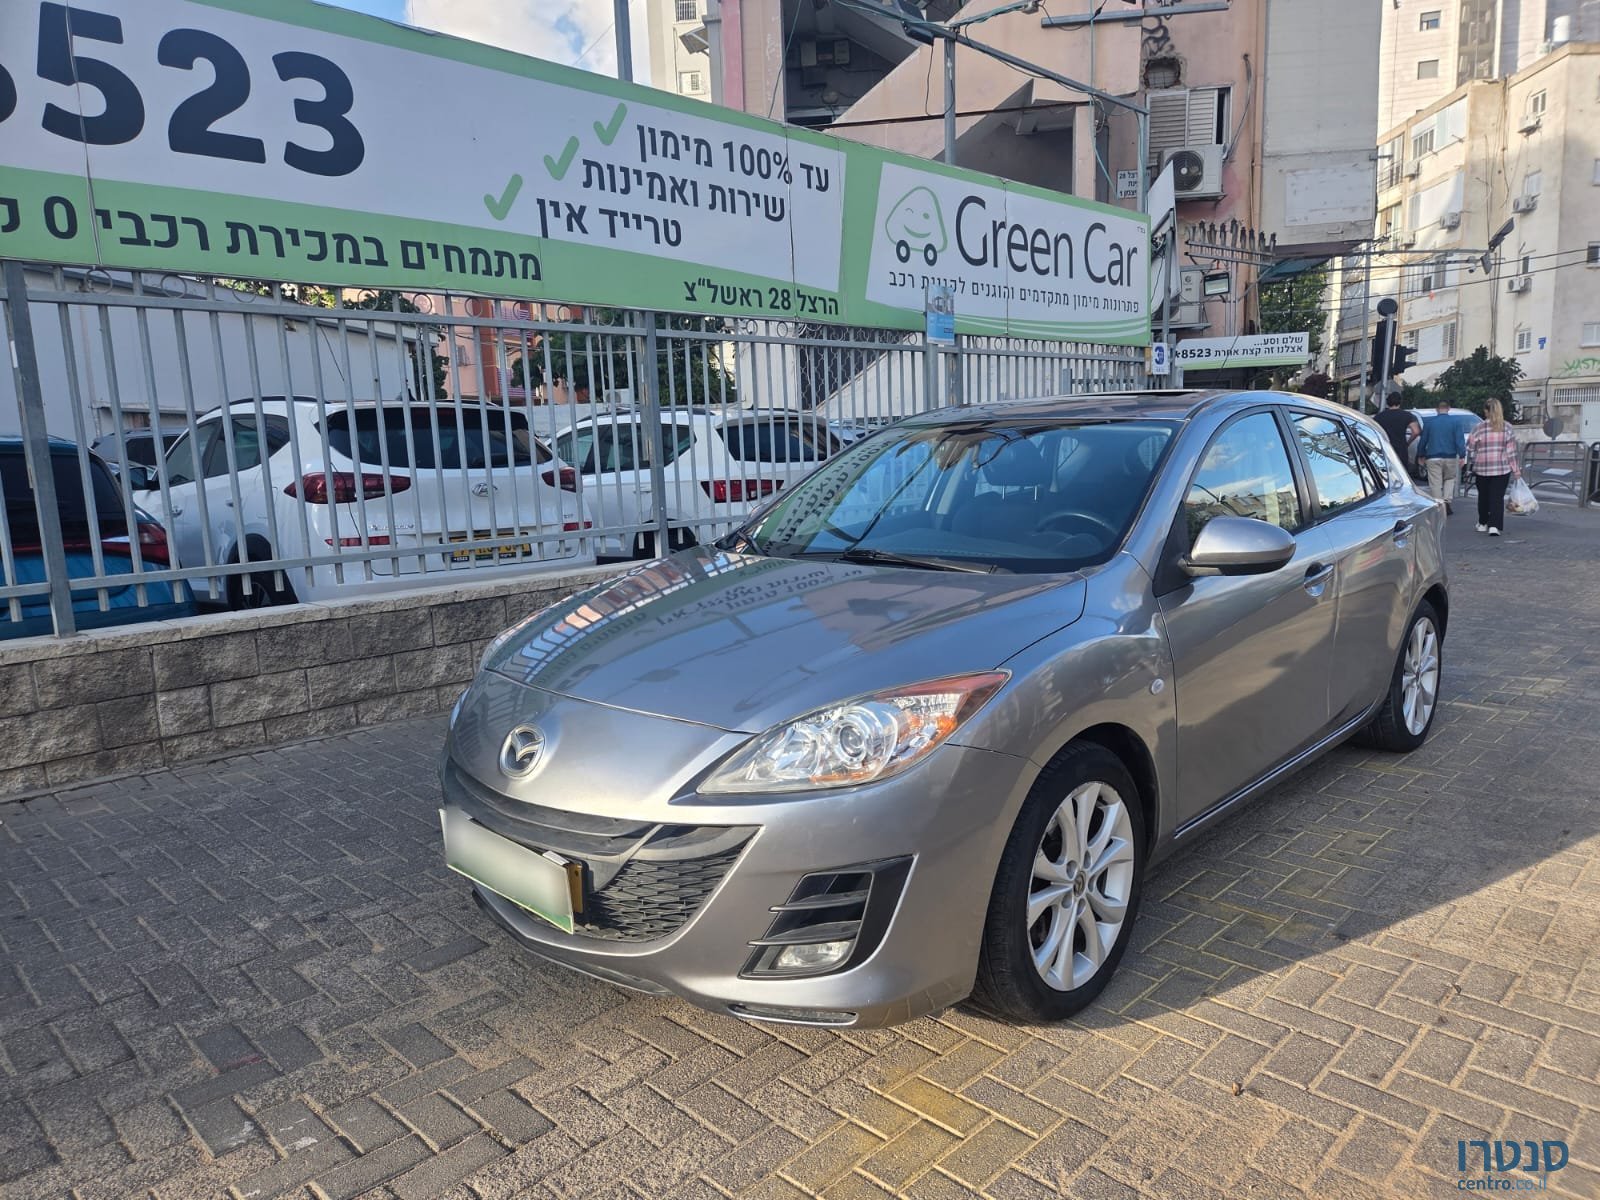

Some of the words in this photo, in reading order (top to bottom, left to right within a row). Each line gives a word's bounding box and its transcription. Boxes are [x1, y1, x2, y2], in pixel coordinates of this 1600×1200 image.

[0, 1, 365, 177] 523
[637, 124, 713, 167] מימון
[722, 141, 793, 185] 100%
[799, 162, 830, 192] עד
[582, 158, 699, 208] ואמינות
[708, 184, 786, 222] שירות
[95, 208, 210, 252] רכבי
[537, 198, 589, 239] אין
[598, 206, 682, 247] טרייד
[226, 221, 389, 268] במכירת
[955, 195, 1074, 280] Green
[1084, 222, 1138, 288] Car
[401, 238, 542, 282] מתמחים
[889, 271, 915, 288] רכב
[971, 281, 1015, 300] והוגנים
[768, 287, 792, 312] 28
[798, 287, 839, 316] הרצל
[1019, 287, 1069, 308] מתקדמים
[1073, 293, 1100, 310] מימון
[1102, 296, 1139, 313] פתרונות
[1241, 347, 1262, 357] קצת
[1264, 346, 1275, 354] זה
[1277, 344, 1304, 354] אצלנו
[1282, 335, 1304, 344] שלם
